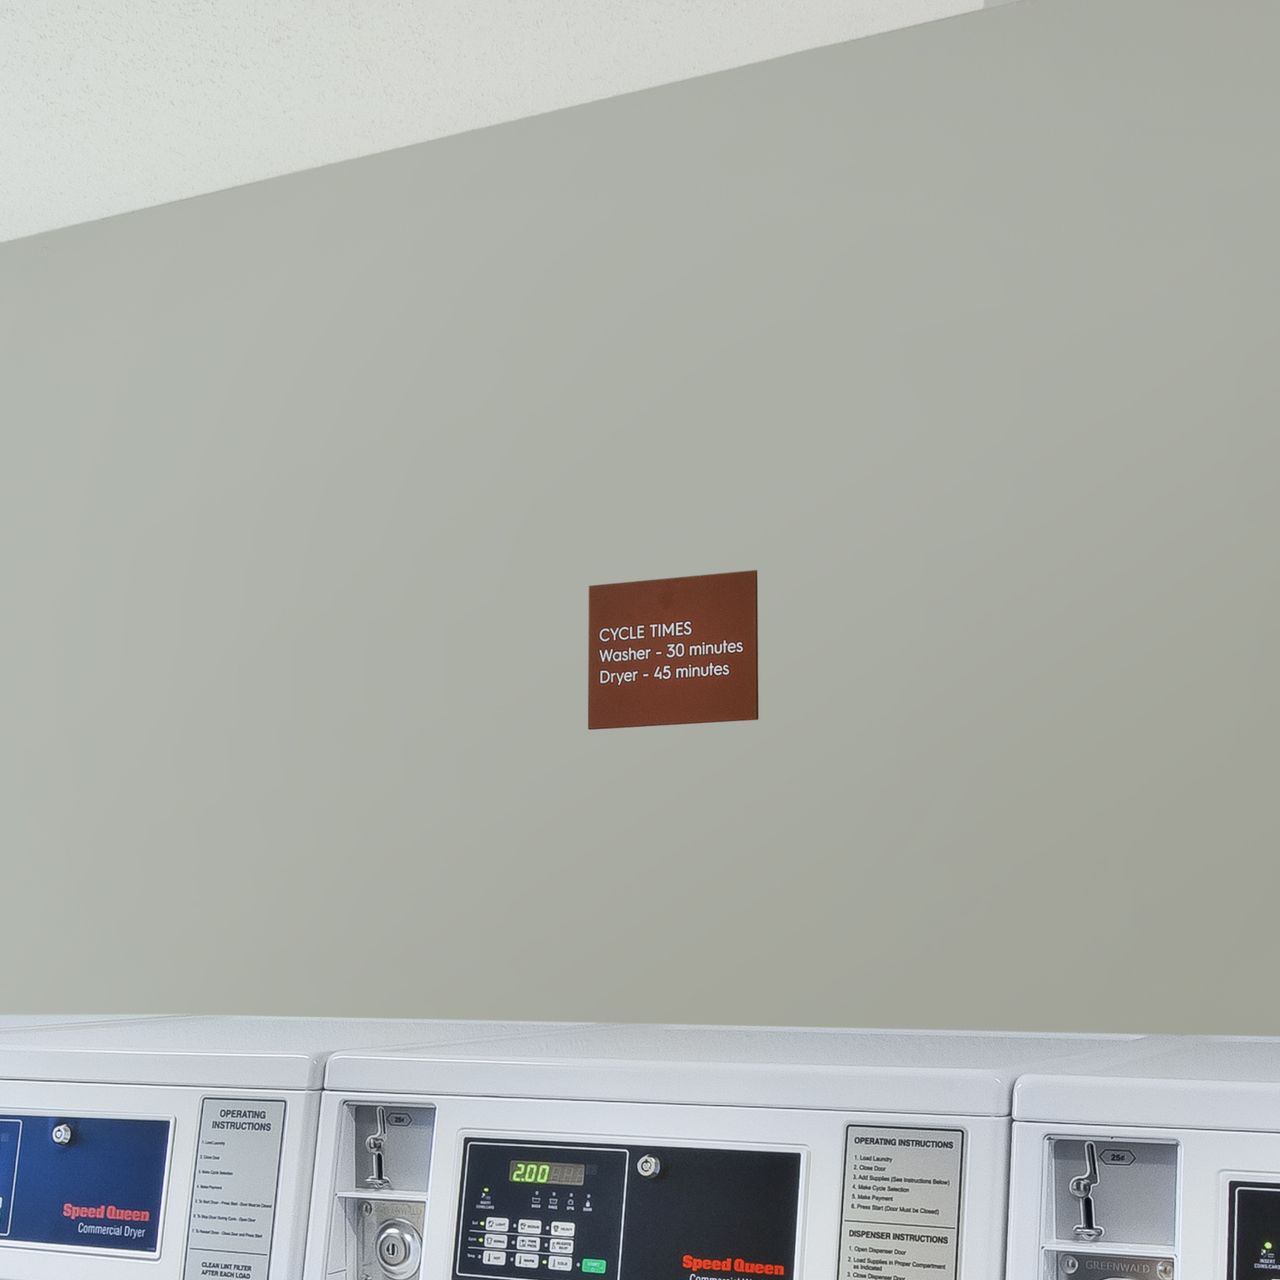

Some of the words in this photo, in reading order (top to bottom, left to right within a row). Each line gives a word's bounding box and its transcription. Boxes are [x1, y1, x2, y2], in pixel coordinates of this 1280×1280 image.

[600, 625, 645, 642] CYCLE
[650, 621, 692, 637] TIMES
[600, 648, 651, 662] Washer
[666, 644, 684, 658] 30
[689, 640, 743, 655] minutes
[600, 670, 638, 685] Dryer
[654, 666, 671, 679] 45
[676, 663, 729, 678] minutes
[220, 1110, 266, 1119] OPERATING
[212, 1121, 271, 1131] INSTRUCTIONS
[854, 1137, 896, 1146] OPERATING
[898, 1139, 954, 1149] INSTRUCTIONS
[512, 1164, 550, 1182] 2.00
[63, 1204, 105, 1219] Speed
[106, 1206, 149, 1221] Queen
[78, 1223, 122, 1235] Commercial
[124, 1226, 145, 1239] Dryer
[849, 1230, 890, 1239] DISPENSER
[893, 1233, 948, 1244] INSTRUCTIONS
[682, 1255, 731, 1271] Speed
[734, 1259, 784, 1275] Queen
[1086, 1261, 1150, 1273] GREENWALD
